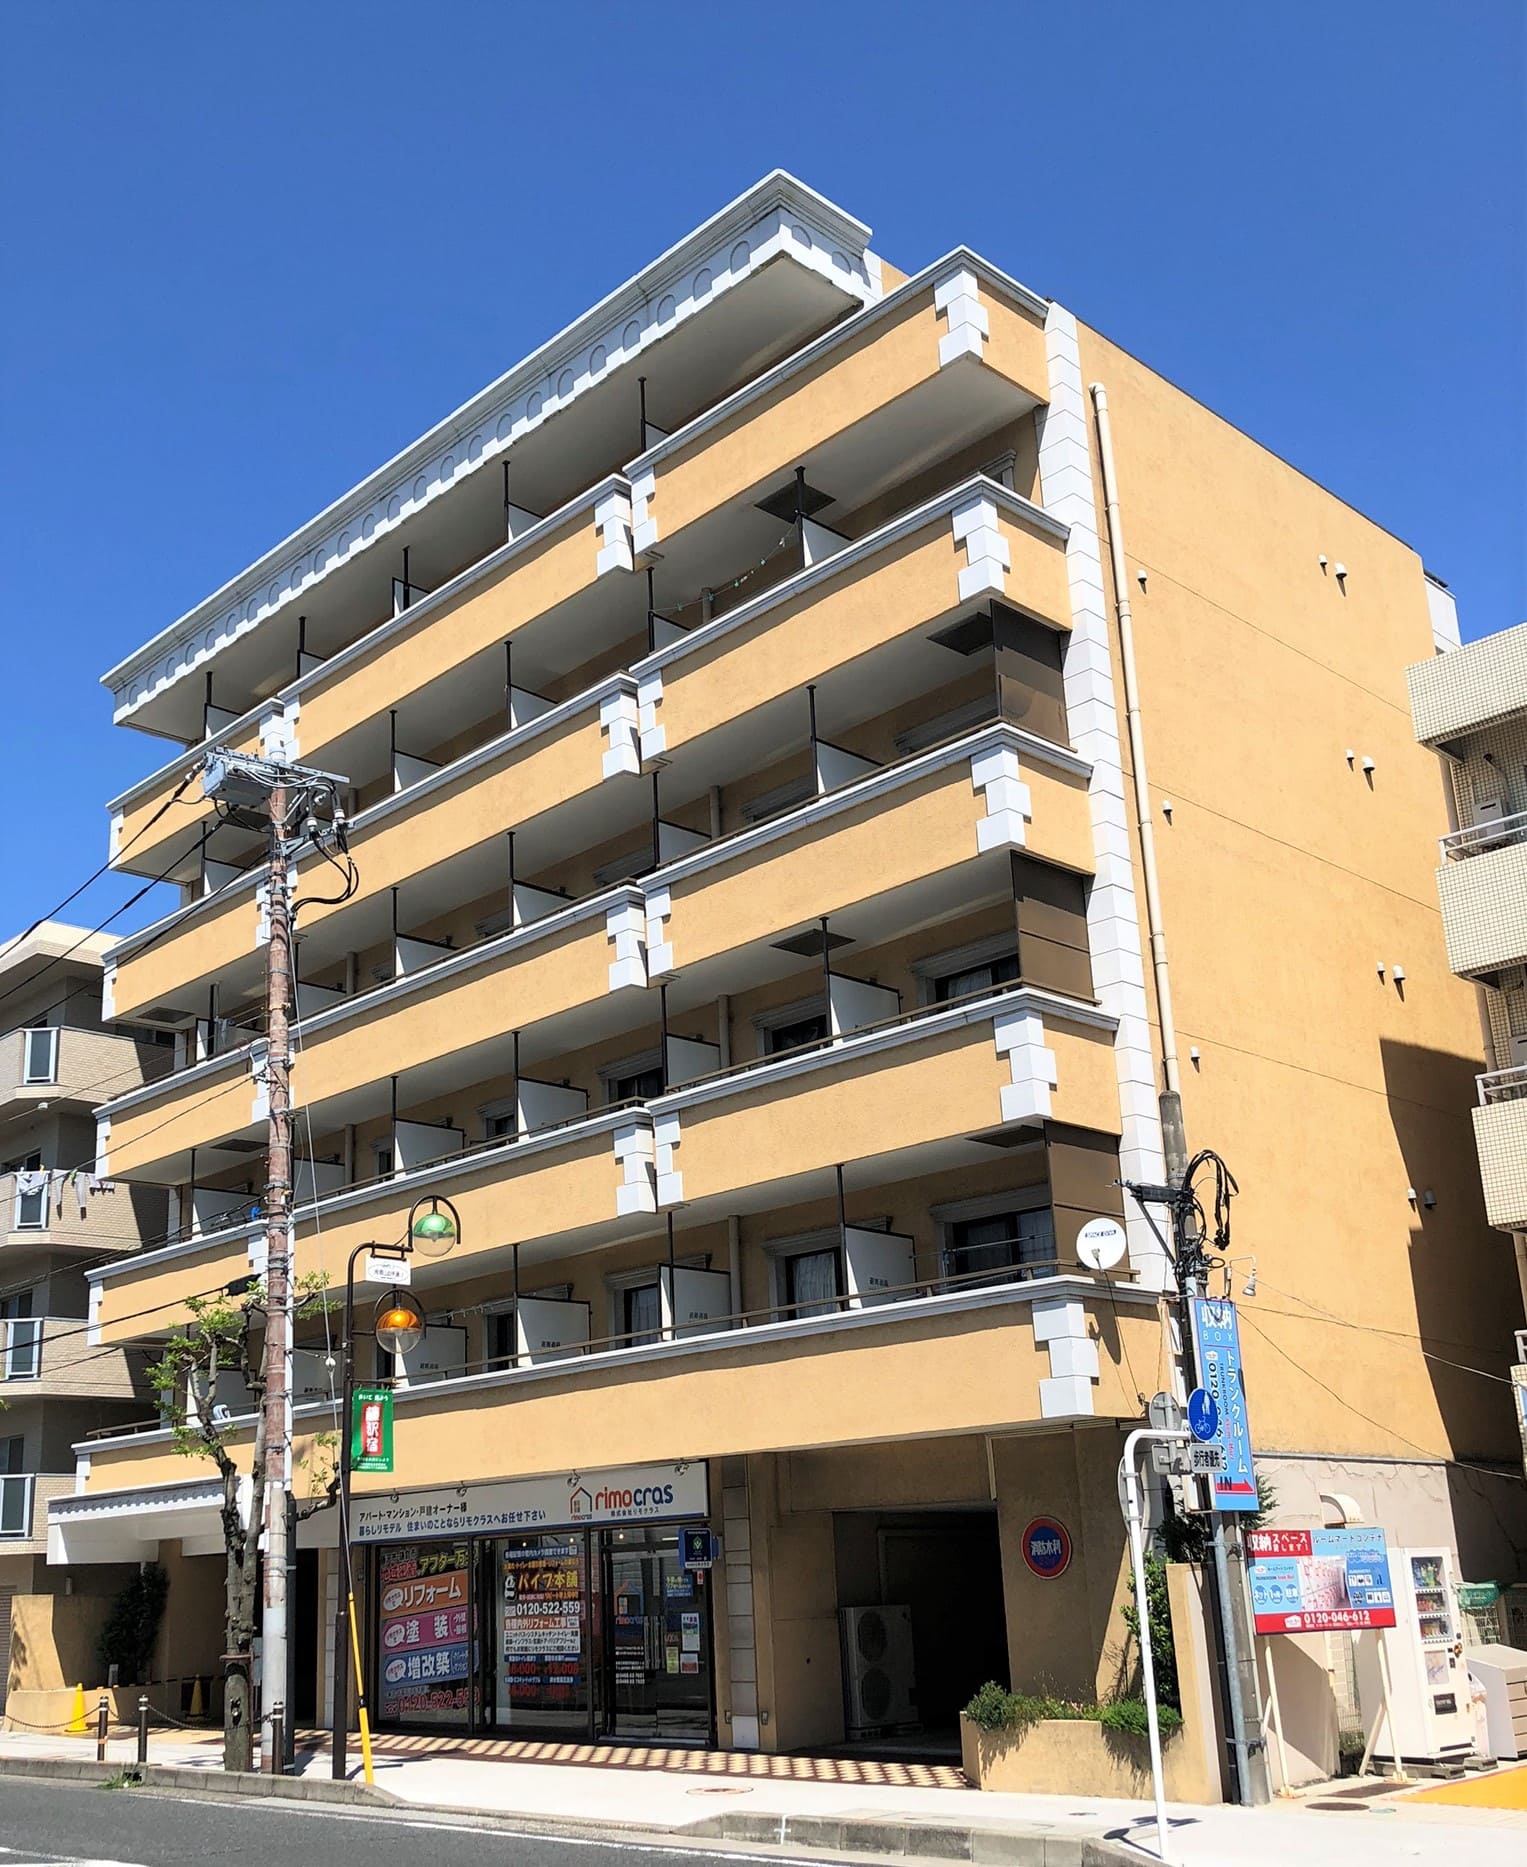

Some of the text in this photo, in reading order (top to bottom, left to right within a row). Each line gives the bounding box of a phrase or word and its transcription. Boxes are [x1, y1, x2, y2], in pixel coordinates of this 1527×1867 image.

[1201, 1303, 1233, 1330] 収納
[1203, 1330, 1233, 1342] BOX
[1227, 1350, 1248, 1474] トランクルーム
[1194, 1450, 1220, 1468] 歩行者優先
[1218, 1476, 1233, 1491] IN
[595, 1484, 674, 1511] rimocras
[1247, 1531, 1308, 1552] 収納 スペース
[1313, 1534, 1383, 1543] ルームマートコンテナ
[1030, 1539, 1062, 1556] 消防水利
[404, 1577, 462, 1608] リフォーム
[516, 1601, 580, 1615] 0120-522-559
[1303, 1610, 1370, 1623] 0120-046-612
[505, 1616, 567, 1630] 各種内外リフォーム工事
[408, 1651, 450, 1680] 増改築
